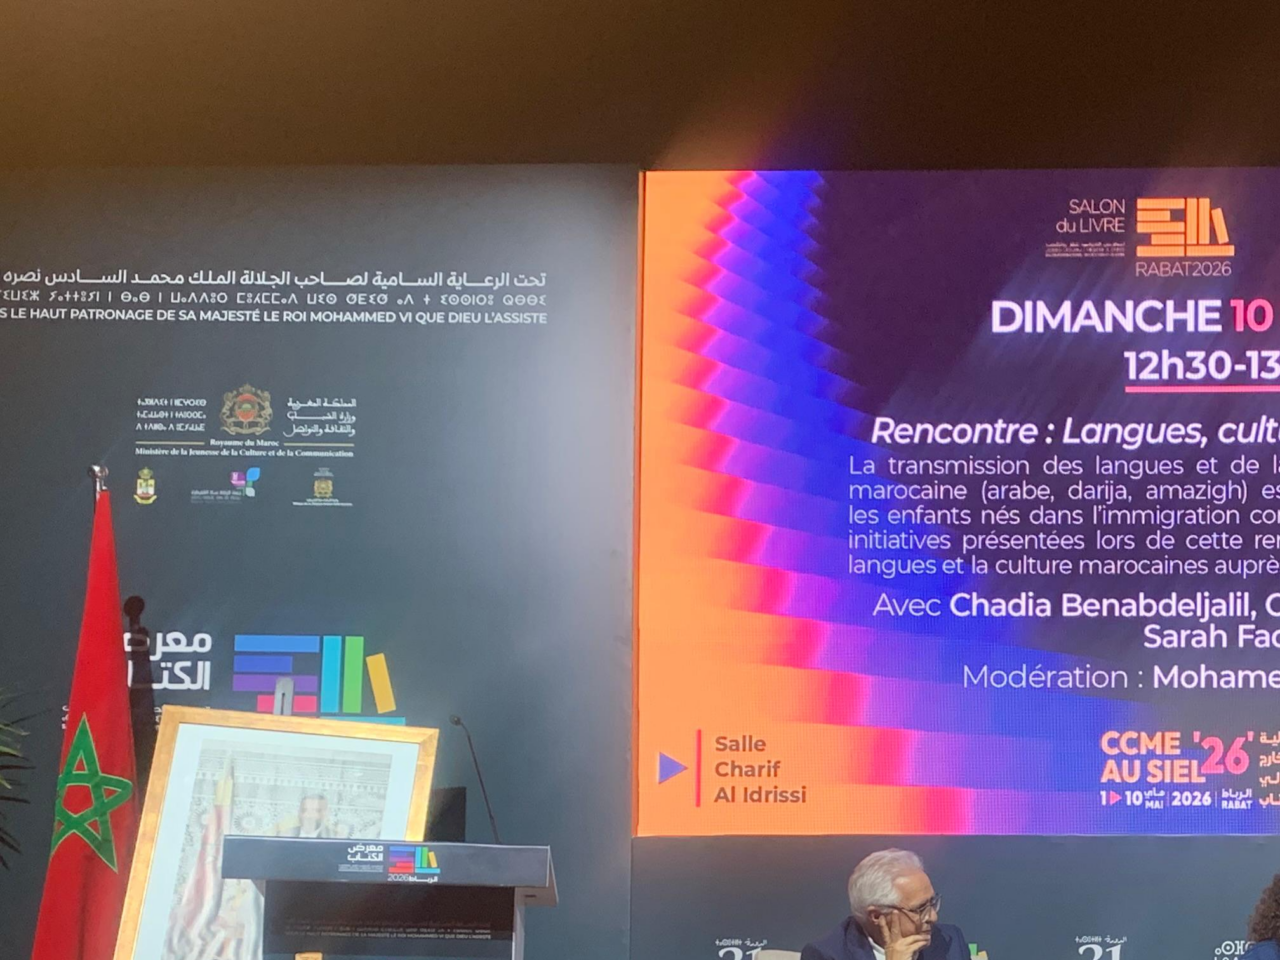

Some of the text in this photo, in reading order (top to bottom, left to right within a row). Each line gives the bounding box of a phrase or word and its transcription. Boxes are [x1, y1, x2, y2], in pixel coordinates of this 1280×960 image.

[1069, 199, 1126, 215] SALON
[1056, 217, 1126, 234] du LIVRE
[3, 269, 42, 284] نصره
[131, 271, 185, 285] محمد
[189, 270, 236, 285] الملك
[240, 270, 291, 288] الجلالة
[1135, 261, 1233, 278] RABAT2026
[513, 272, 547, 287] تحت
[11, 308, 27, 319] LE
[30, 308, 68, 320] HAUT
[71, 309, 154, 321] PATRONAGE
[157, 310, 176, 321] DE
[179, 310, 197, 321] SA
[200, 308, 261, 322] MAJESTÉ
[264, 311, 280, 322] LE
[283, 311, 307, 322] ROI
[310, 311, 397, 323] MOHAMMED
[399, 311, 413, 323] VI
[415, 312, 445, 325] QUE
[448, 312, 481, 323] DIEU
[485, 312, 548, 324] L'ASSISTE
[991, 300, 1223, 333] DIMANCHE
[1230, 299, 1274, 333] 10
[872, 417, 1039, 445] Rencontre
[1063, 416, 1208, 451] Langues,
[135, 448, 170, 456] Ministère
[171, 448, 180, 456] de
[181, 448, 188, 456] la
[189, 449, 220, 458] Jeunesse
[221, 449, 230, 457] de
[231, 449, 239, 457] la
[239, 449, 267, 458] Culture
[276, 449, 286, 458] de
[287, 449, 294, 458] la
[295, 450, 354, 459] Communication
[210, 439, 280, 449] Royaume du Maroc
[849, 456, 875, 475] La
[888, 455, 1030, 475] transmission
[1043, 455, 1084, 475] des
[1096, 455, 1184, 480] langues
[1196, 458, 1219, 475] et
[1231, 455, 1260, 475] de
[849, 481, 968, 500] marocaine
[981, 480, 1055, 505] (arabe,
[1068, 480, 1132, 505] darija,
[1146, 480, 1248, 505] amazigh)
[849, 505, 880, 525] les
[888, 505, 972, 525] enfants
[981, 505, 1021, 525] nés
[1029, 505, 1084, 525] dans
[1093, 505, 1241, 530] l'immigration
[848, 530, 952, 550] initiatives
[963, 530, 1085, 555] présentées
[1097, 530, 1136, 550] lors
[1146, 530, 1176, 550] de
[1186, 532, 1243, 550] cette
[848, 555, 937, 579] langues
[942, 557, 965, 575] et
[971, 555, 988, 575] la
[995, 555, 1073, 575] culture
[1080, 555, 1209, 575] marocaines
[872, 593, 942, 617] Avec
[949, 592, 1052, 618] Chadia
[1061, 592, 1257, 622] Benabdeljalil,
[1143, 624, 1228, 649] Sarah
[963, 664, 1129, 689] Modération
[715, 735, 767, 754] Salle
[1101, 731, 1181, 756] CCME
[715, 758, 781, 780] Charif
[1101, 759, 1207, 784] AU SIEL
[715, 785, 808, 805] Al Idrissi
[1100, 791, 1253, 810] 1 10 MAI 2026 RABAT
[1222, 788, 1253, 800] الرباط
